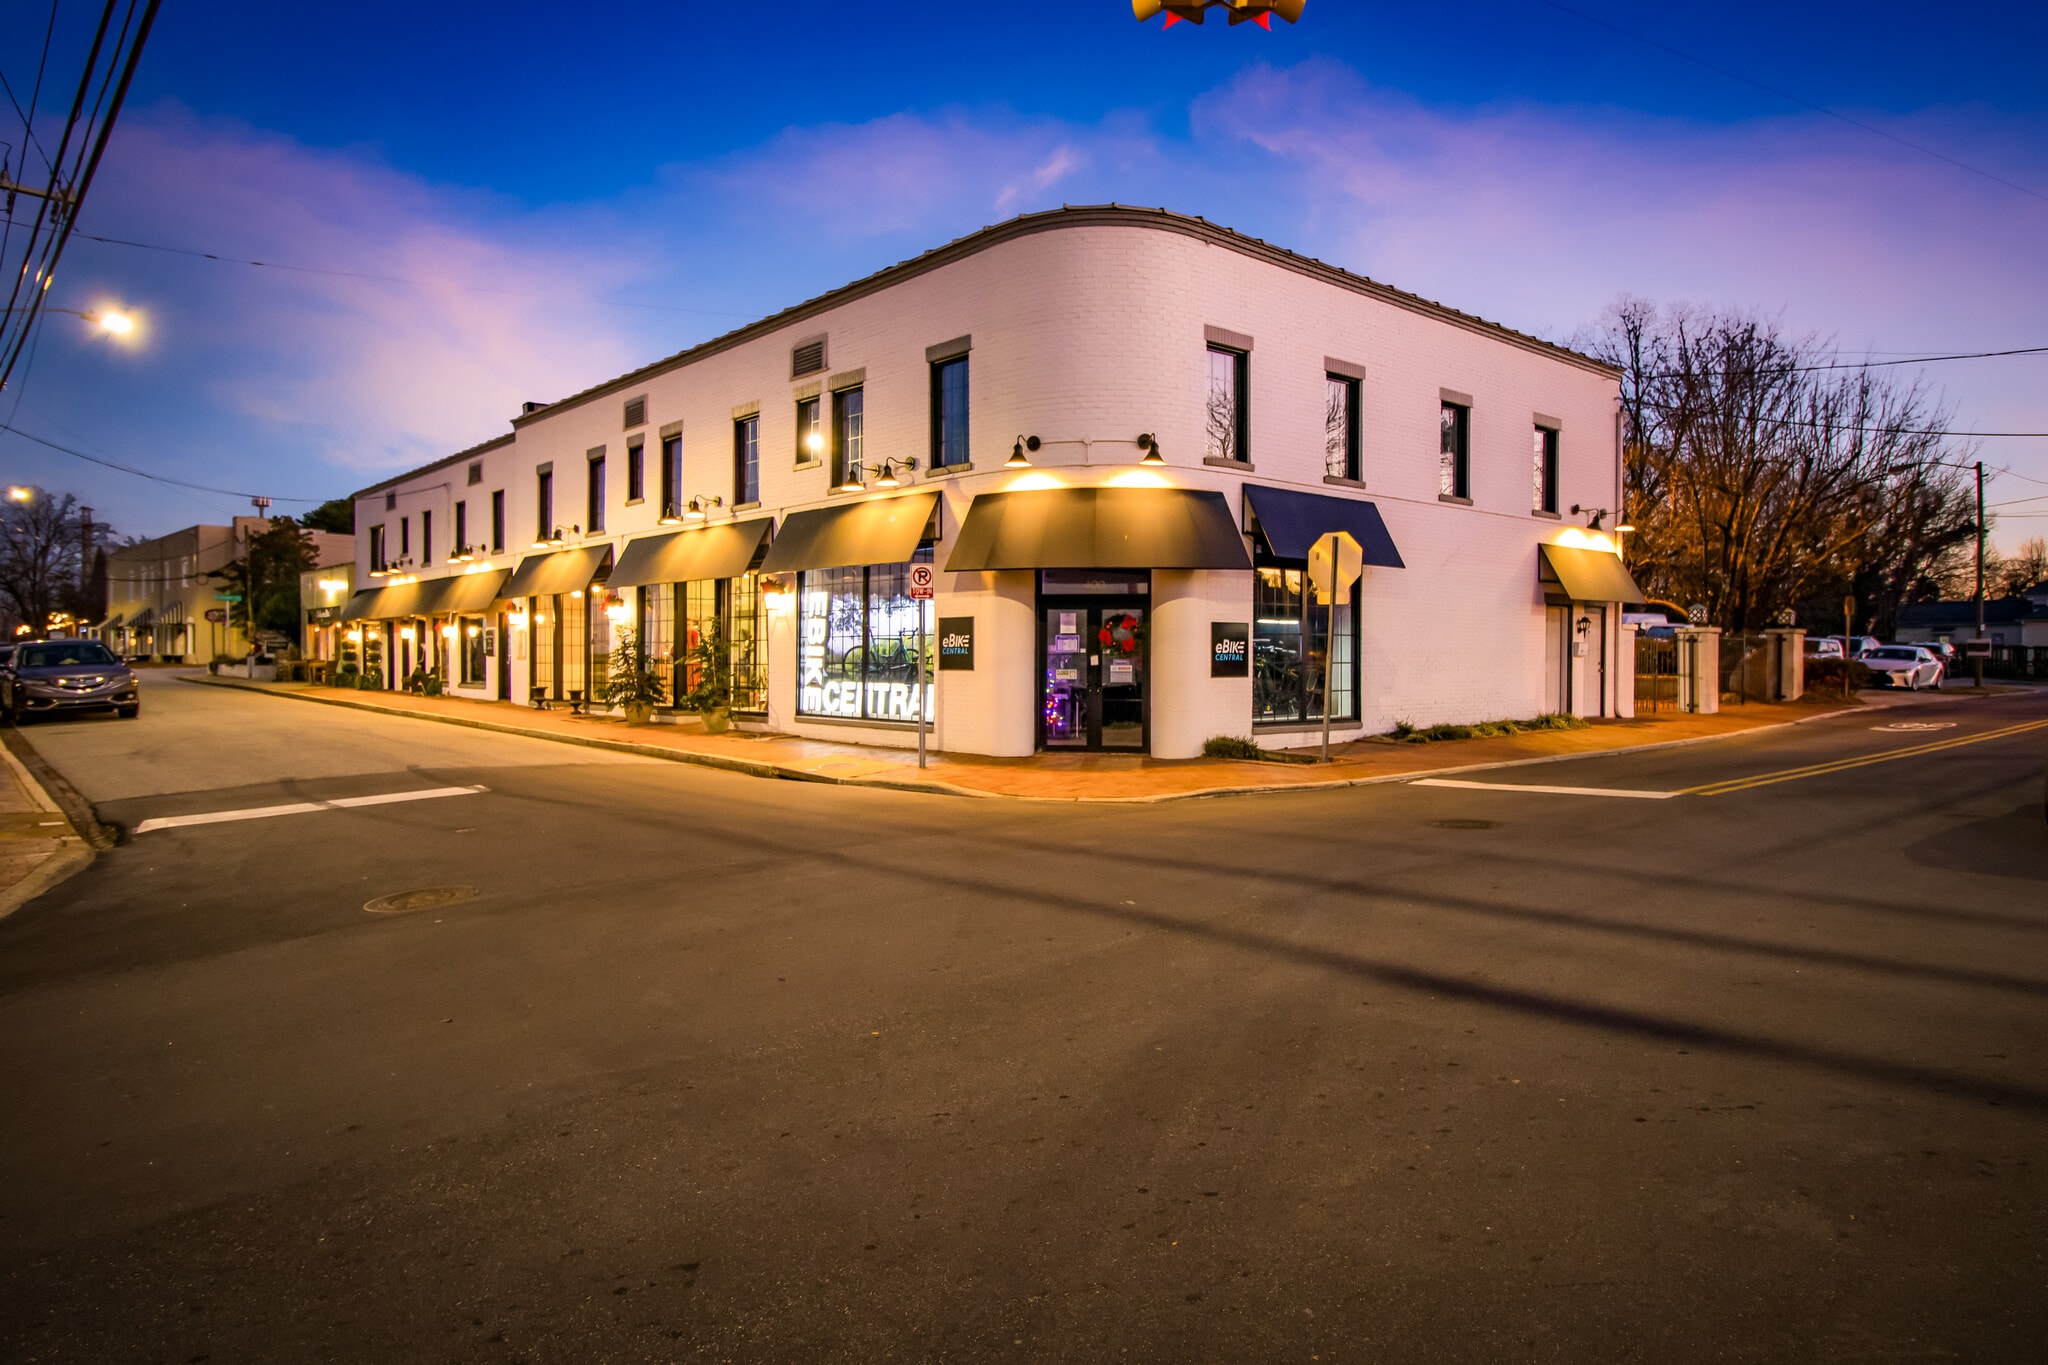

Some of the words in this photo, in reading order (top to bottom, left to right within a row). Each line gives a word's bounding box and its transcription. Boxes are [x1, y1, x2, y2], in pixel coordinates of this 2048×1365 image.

[942, 633, 970, 647] eBIKE
[1215, 638, 1245, 654] eBIKE
[803, 592, 828, 711] EBIKE
[1215, 653, 1243, 661] CENTRAL
